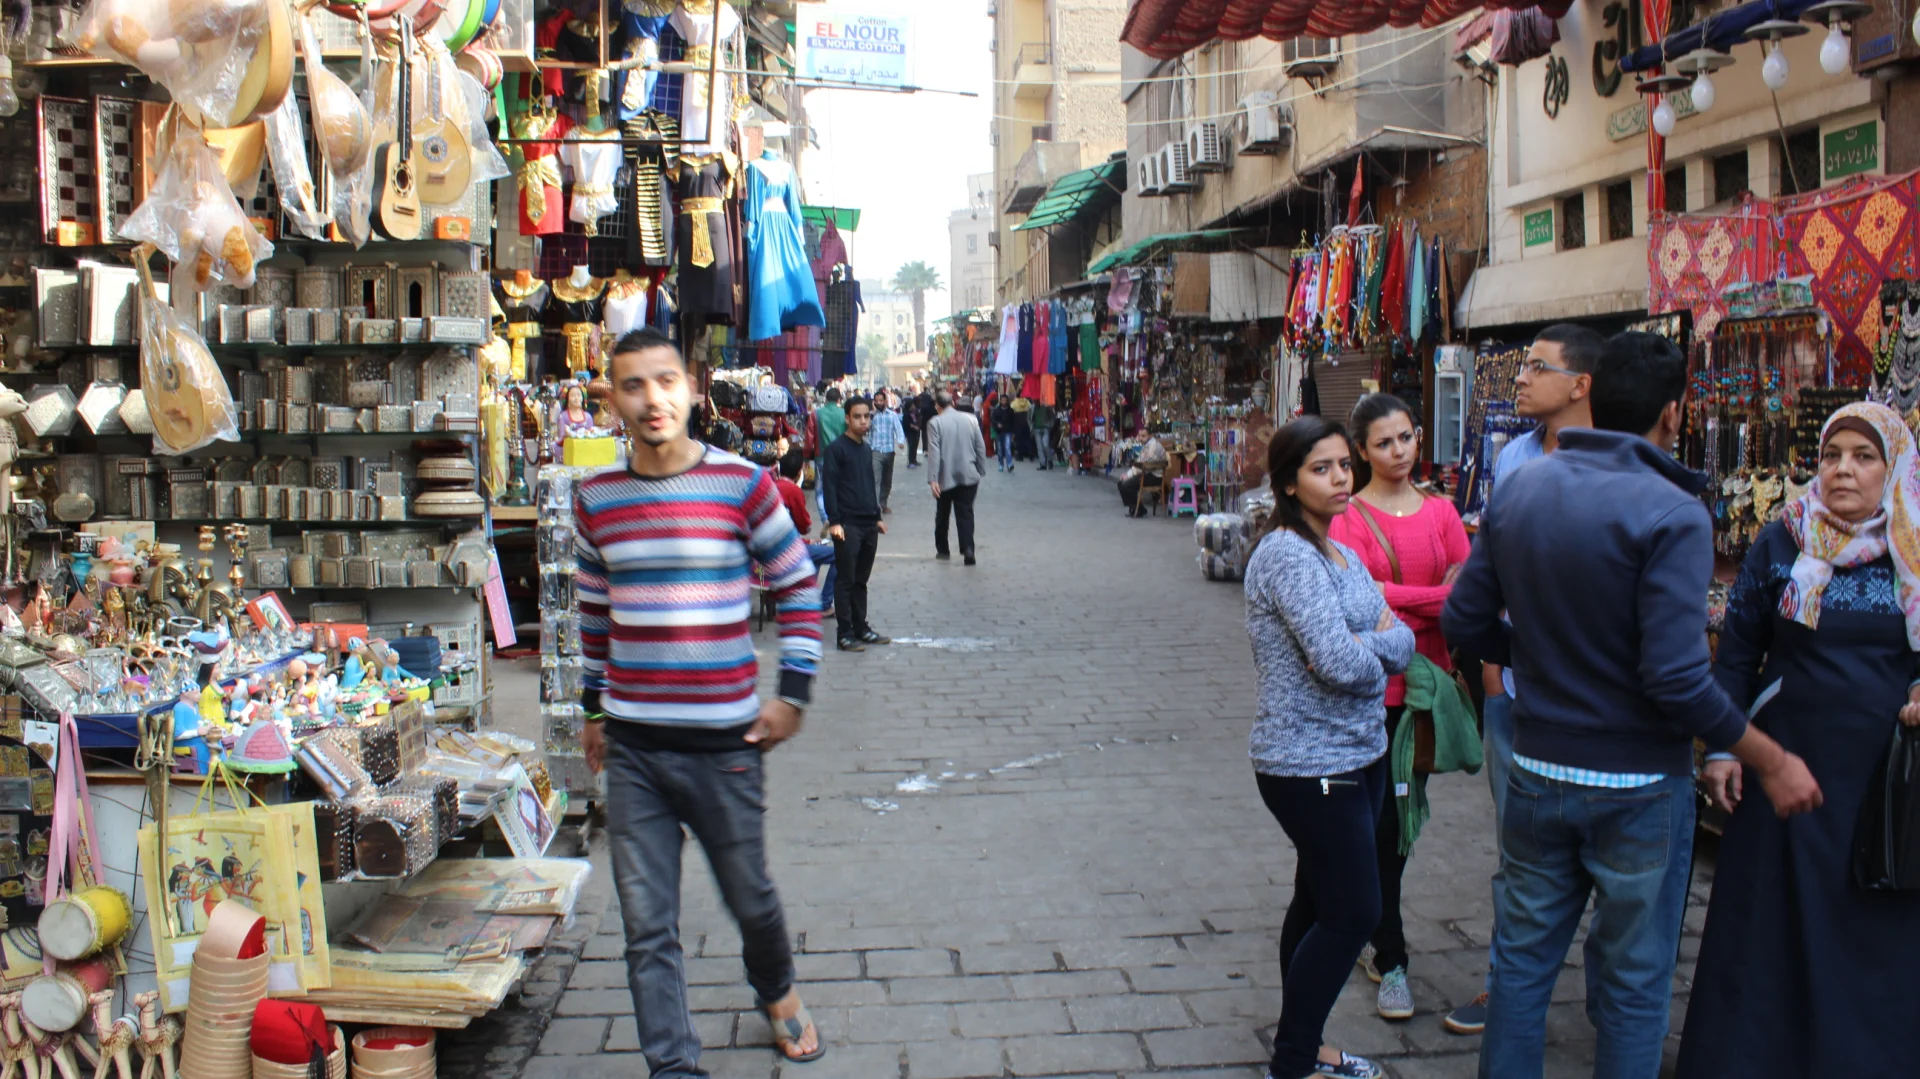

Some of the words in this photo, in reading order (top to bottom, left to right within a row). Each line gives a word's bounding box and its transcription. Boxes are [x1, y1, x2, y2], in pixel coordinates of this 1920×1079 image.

[816, 21, 838, 38] EL
[844, 24, 899, 42] NOUR
[858, 16, 887, 26] Cotton
[811, 38, 824, 47] EL
[826, 40, 856, 50] NOUR
[858, 42, 901, 53] COTTON
[1827, 143, 1877, 172] ٥٩٠٧٤١٨
[512, 835, 527, 857] GLASS
